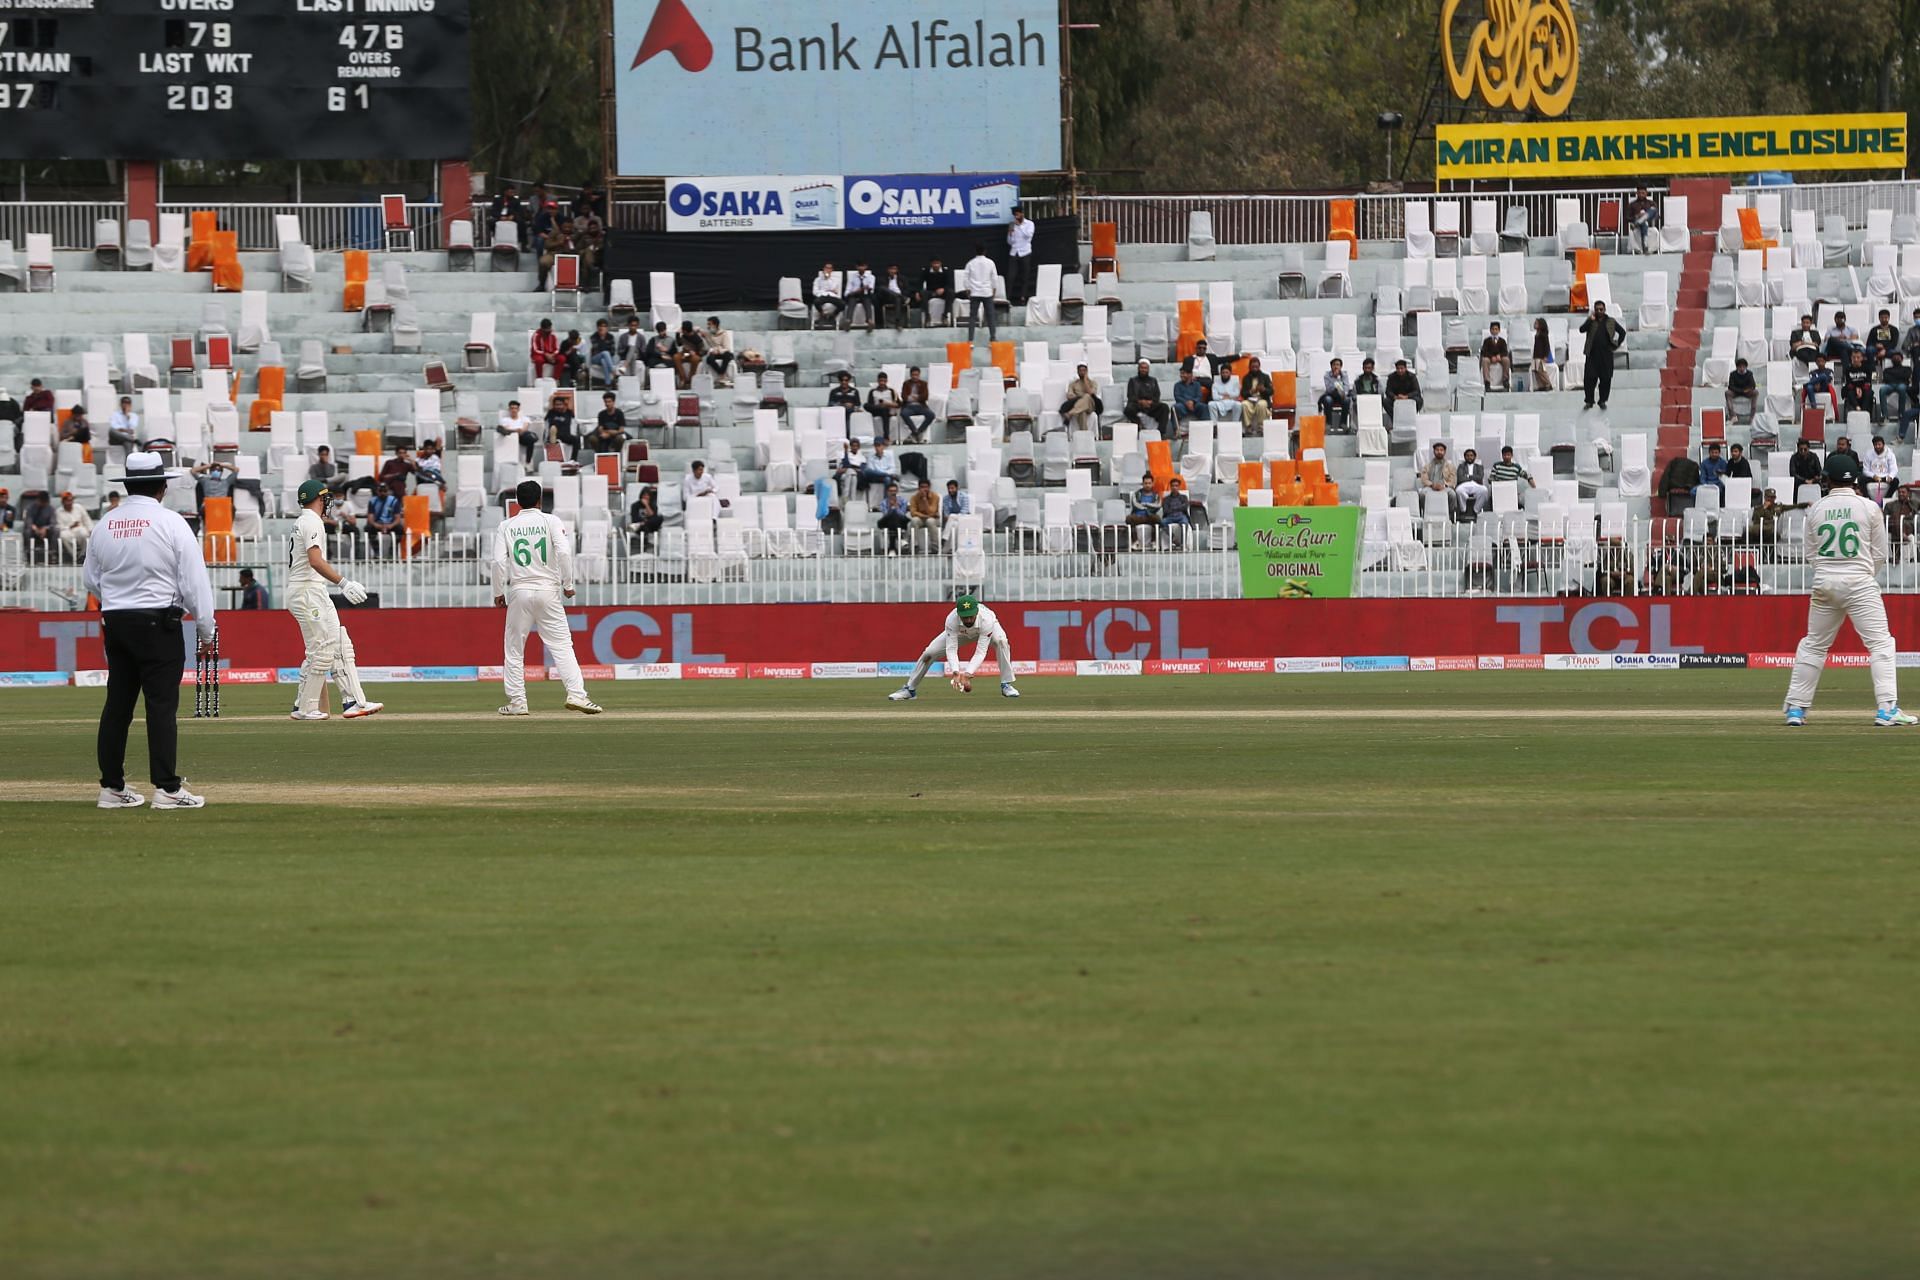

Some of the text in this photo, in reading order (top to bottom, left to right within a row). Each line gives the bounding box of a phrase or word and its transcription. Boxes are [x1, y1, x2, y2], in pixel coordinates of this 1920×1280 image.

[189, 22, 231, 48] 79
[338, 24, 404, 49] 476
[735, 18, 1045, 72] Bank Alfalah
[0, 52, 71, 72] TMAN
[139, 53, 252, 73] LAST WKT
[349, 52, 392, 64] OVERS
[337, 66, 401, 78] REMAINING
[167, 85, 233, 110] 203
[328, 84, 369, 111] 61
[1438, 127, 1905, 166] MIRAN BAKHSH ENCLOSURE
[669, 183, 784, 216] OSAKA
[849, 180, 965, 215] OSAKA
[700, 218, 753, 227] BATTERIES
[880, 216, 934, 225] BATTERIES
[1825, 508, 1851, 520] IMAM
[108, 518, 150, 530] Emirates
[113, 529, 142, 539] FLY BETTER
[510, 526, 547, 536] NAUMAN
[1817, 521, 1860, 558] 26
[513, 537, 547, 567] 61
[1264, 550, 1292, 558] Natural
[1309, 550, 1327, 558] Pure
[1268, 563, 1323, 576] ORIGINAL
[1023, 607, 1209, 660] TCL
[1496, 602, 1704, 654] TCL
[1227, 660, 1266, 668] INVEREX
[1614, 655, 1644, 664] OSAKA
[1647, 655, 1677, 664] OSAKA
[1765, 656, 1795, 664] INVER
[1832, 654, 1871, 663] INVEREX
[642, 665, 670, 673] TRANS
[697, 666, 737, 675] INVEREX
[764, 667, 803, 675] INVEREX
[1103, 662, 1131, 670] TRANS
[1162, 663, 1201, 671] INVEREX
[228, 671, 270, 680] INVEREX
